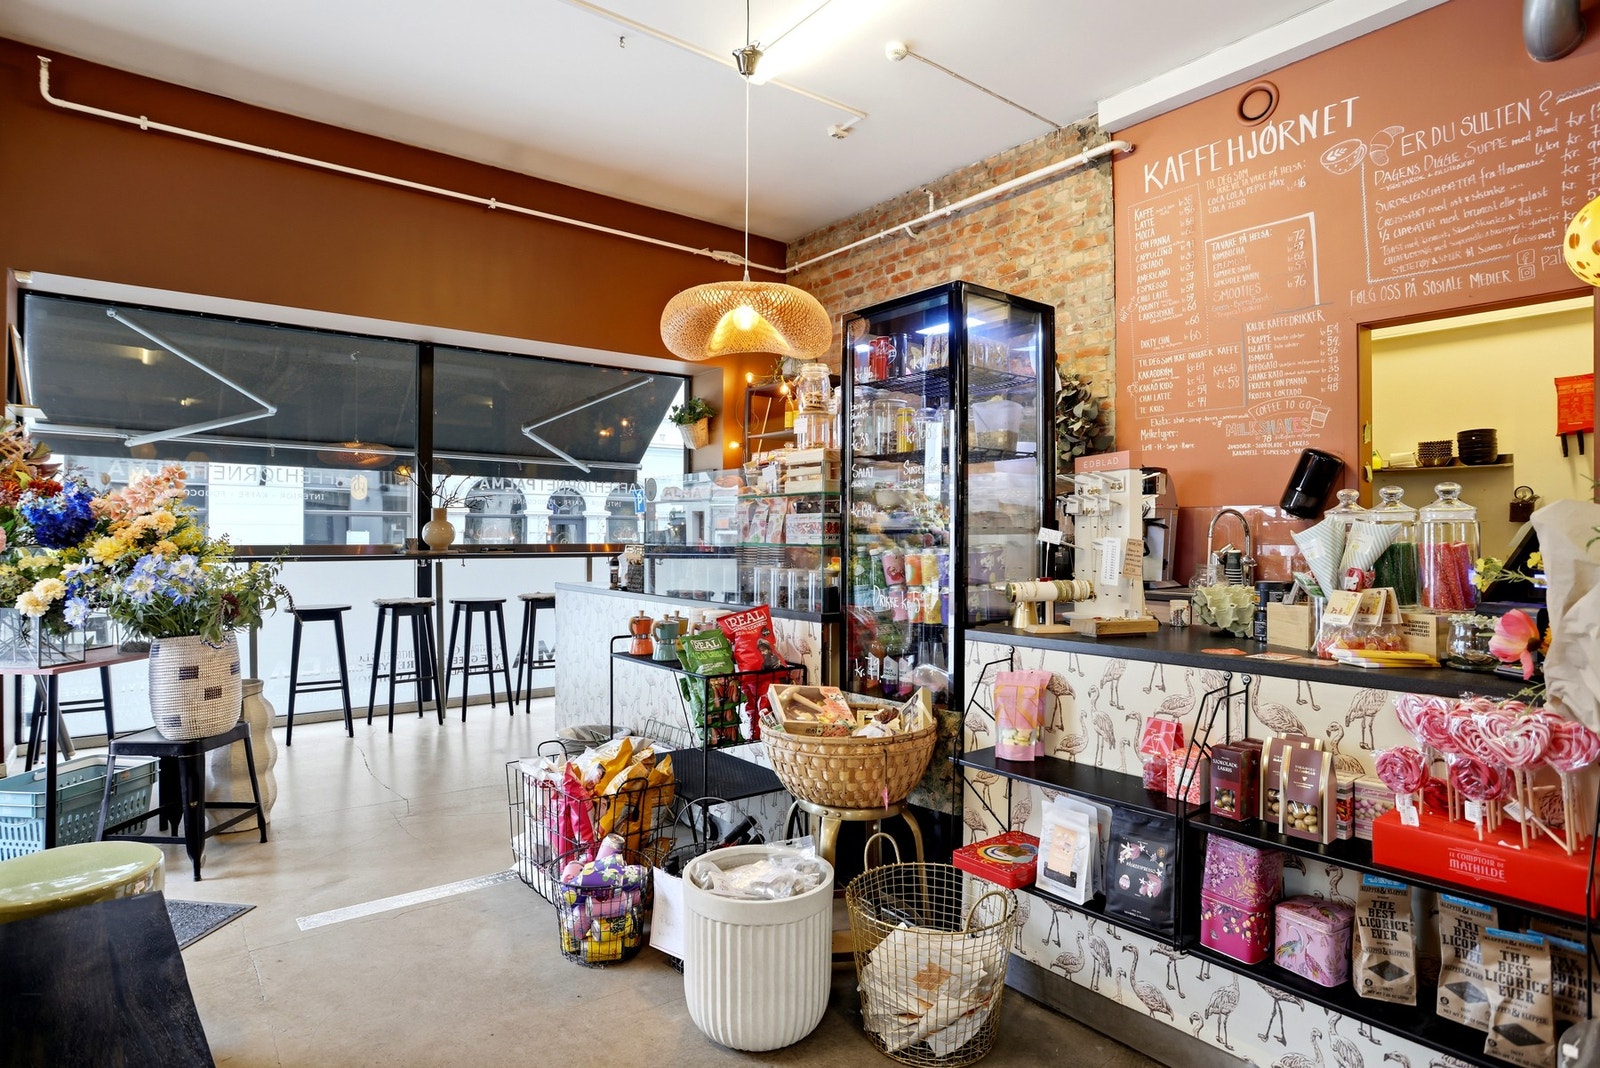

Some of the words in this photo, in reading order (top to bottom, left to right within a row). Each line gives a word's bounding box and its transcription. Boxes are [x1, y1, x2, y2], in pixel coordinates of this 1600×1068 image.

[1401, 130, 1427, 156] ER
[1431, 122, 1456, 147] DU
[1460, 98, 1531, 136] SULTEN
[1144, 96, 1360, 194] KAFFEHJØRNET
[1374, 163, 1421, 186] DAGENS
[1464, 136, 1508, 159] SUPPE
[1269, 178, 1285, 189] MAX
[1134, 206, 1155, 222] KAFFE
[1135, 218, 1155, 231] LATTE
[1350, 288, 1377, 306] FØLG
[1380, 282, 1401, 301] OSS
[1405, 277, 1418, 298] PÅ
[1422, 274, 1464, 297] SOSIALE
[1470, 269, 1513, 289] MEDIER
[1267, 310, 1325, 330] KAFFEDRIKKER
[1217, 345, 1239, 355] KAFFE
[1255, 400, 1281, 416] COFFEE
[1285, 400, 1295, 409] TO
[1298, 400, 1312, 410] GO
[1083, 456, 1120, 469] EDBLAD
[728, 611, 765, 628] REAL
[693, 639, 720, 650] REAL
[1456, 852, 1495, 867] COMPTOIR
[1449, 858, 1505, 880] MATHILDE
[1371, 900, 1395, 910] THE
[1368, 908, 1396, 919] BEST
[1358, 917, 1408, 932] LICORICE
[1371, 929, 1398, 941] EVER
[1500, 950, 1530, 966] THE
[1498, 960, 1533, 979] BEST
[1485, 969, 1549, 996] LICORICE
[1498, 984, 1535, 1004] EVER
